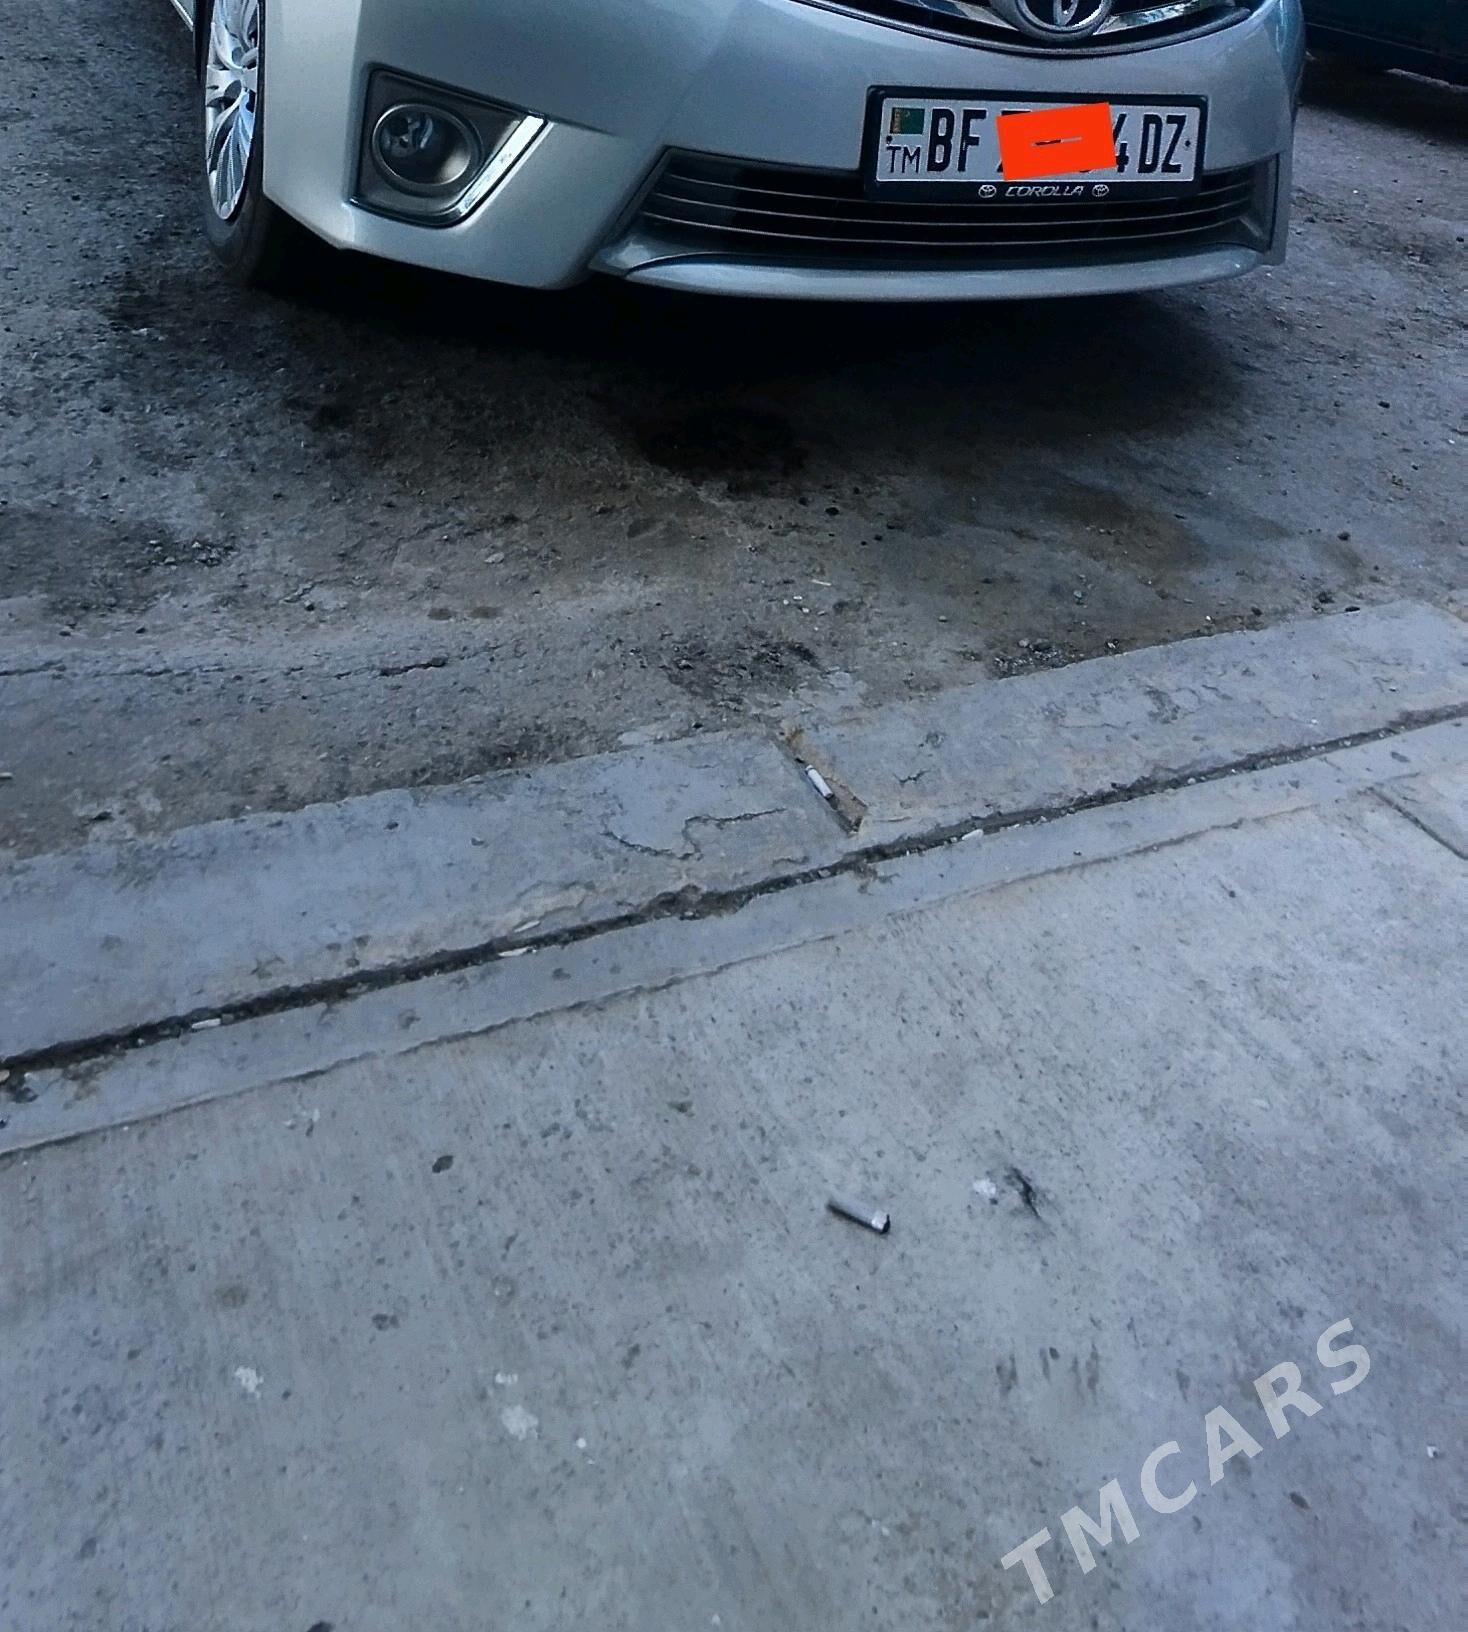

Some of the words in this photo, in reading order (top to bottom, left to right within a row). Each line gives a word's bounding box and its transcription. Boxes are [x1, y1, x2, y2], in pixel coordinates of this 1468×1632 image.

[927, 108, 987, 173] BF
[1138, 113, 1187, 173] DZ
[886, 145, 921, 173] TM
[1004, 184, 1085, 198] COROLLA
